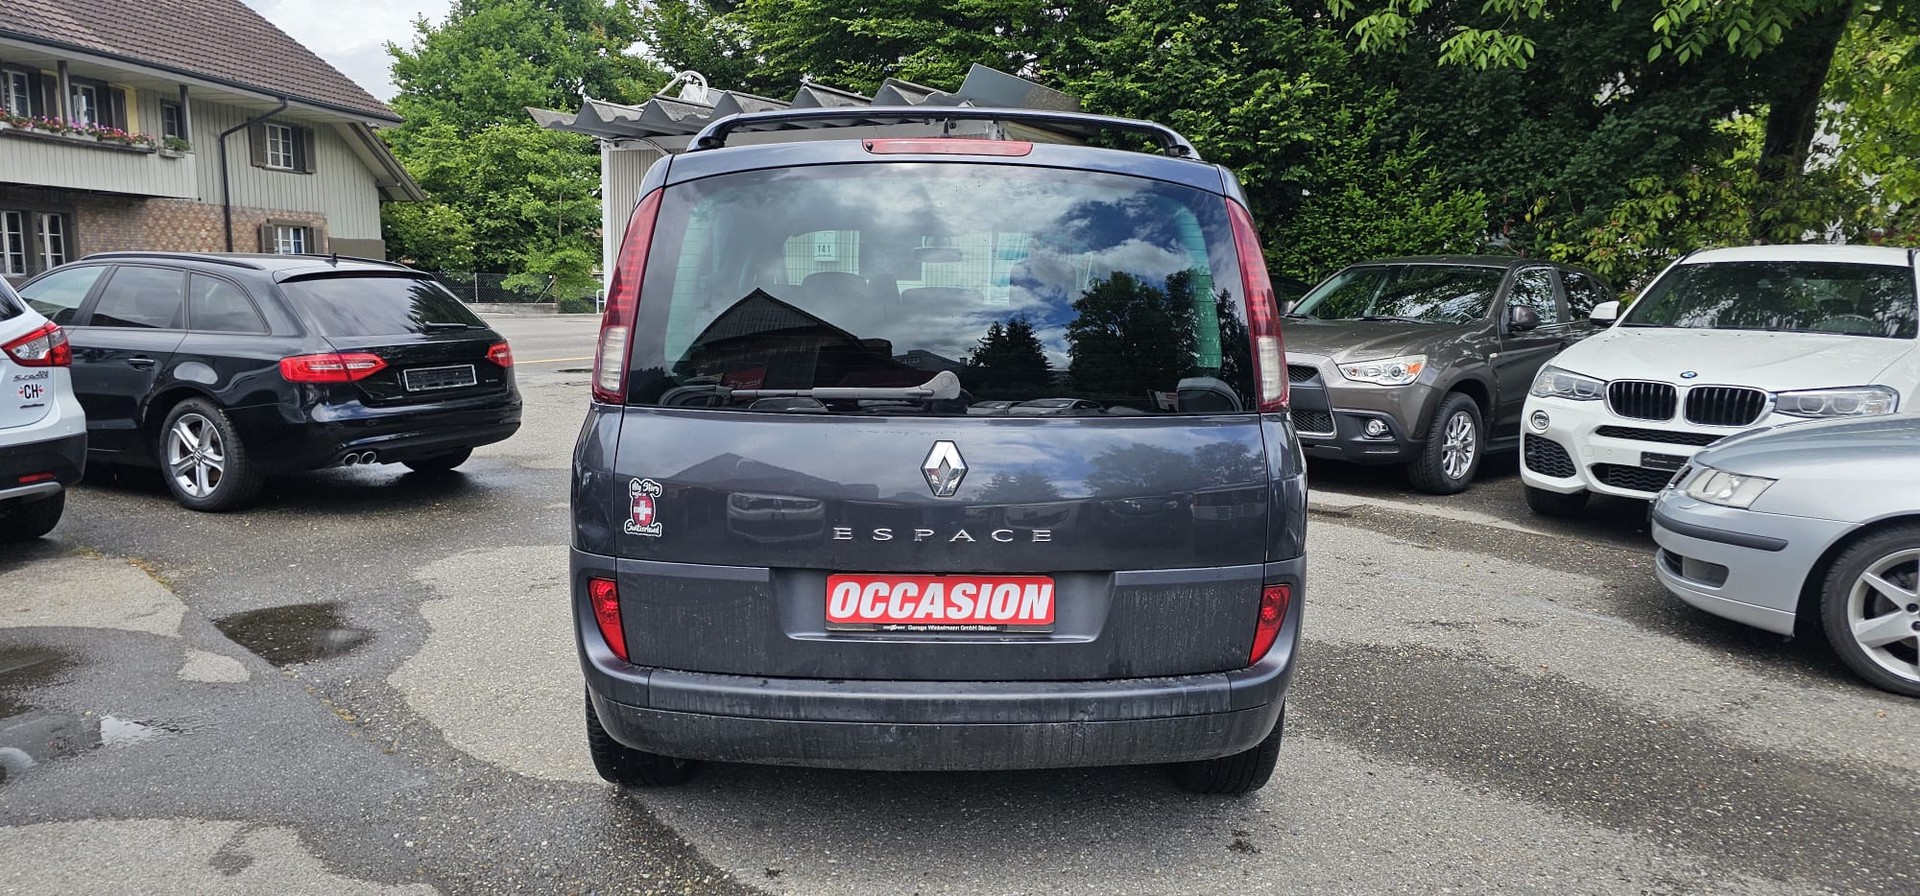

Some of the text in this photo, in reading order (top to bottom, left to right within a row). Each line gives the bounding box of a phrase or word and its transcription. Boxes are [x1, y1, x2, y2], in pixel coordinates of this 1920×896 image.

[24, 383, 39, 399] CH
[832, 527, 1052, 542] ESPACE
[829, 581, 1053, 619] OCCASION
[907, 624, 927, 632] Garage
